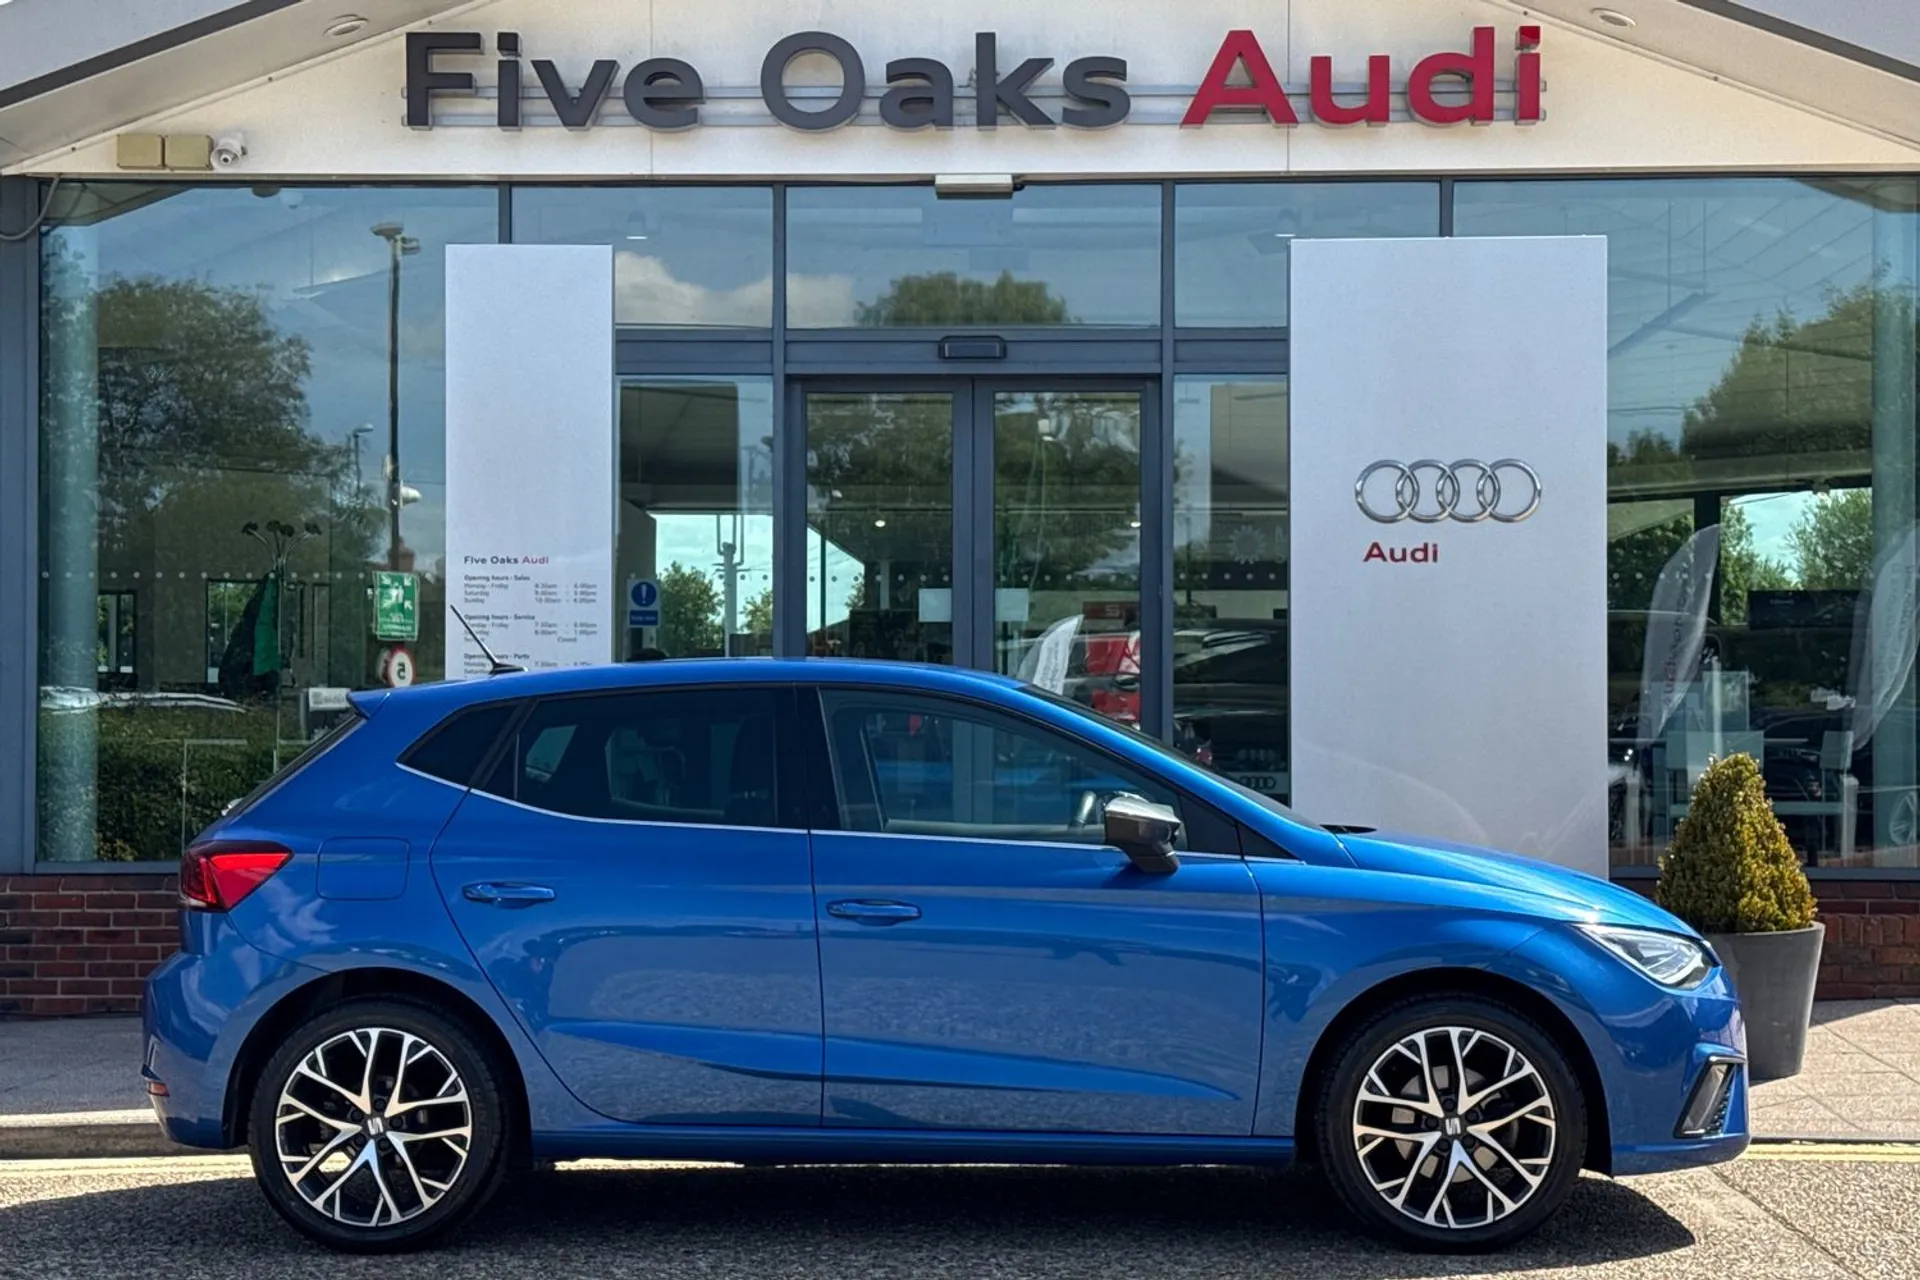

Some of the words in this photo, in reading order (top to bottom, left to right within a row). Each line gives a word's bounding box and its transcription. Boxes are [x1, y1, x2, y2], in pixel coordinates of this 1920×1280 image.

[405, 31, 705, 131] Five
[760, 30, 1132, 131] Oaks
[1180, 25, 1542, 129] Audi
[464, 555, 487, 565] Five
[490, 555, 519, 565] Oaks
[522, 555, 549, 565] Audi
[1363, 541, 1439, 563] Audi
